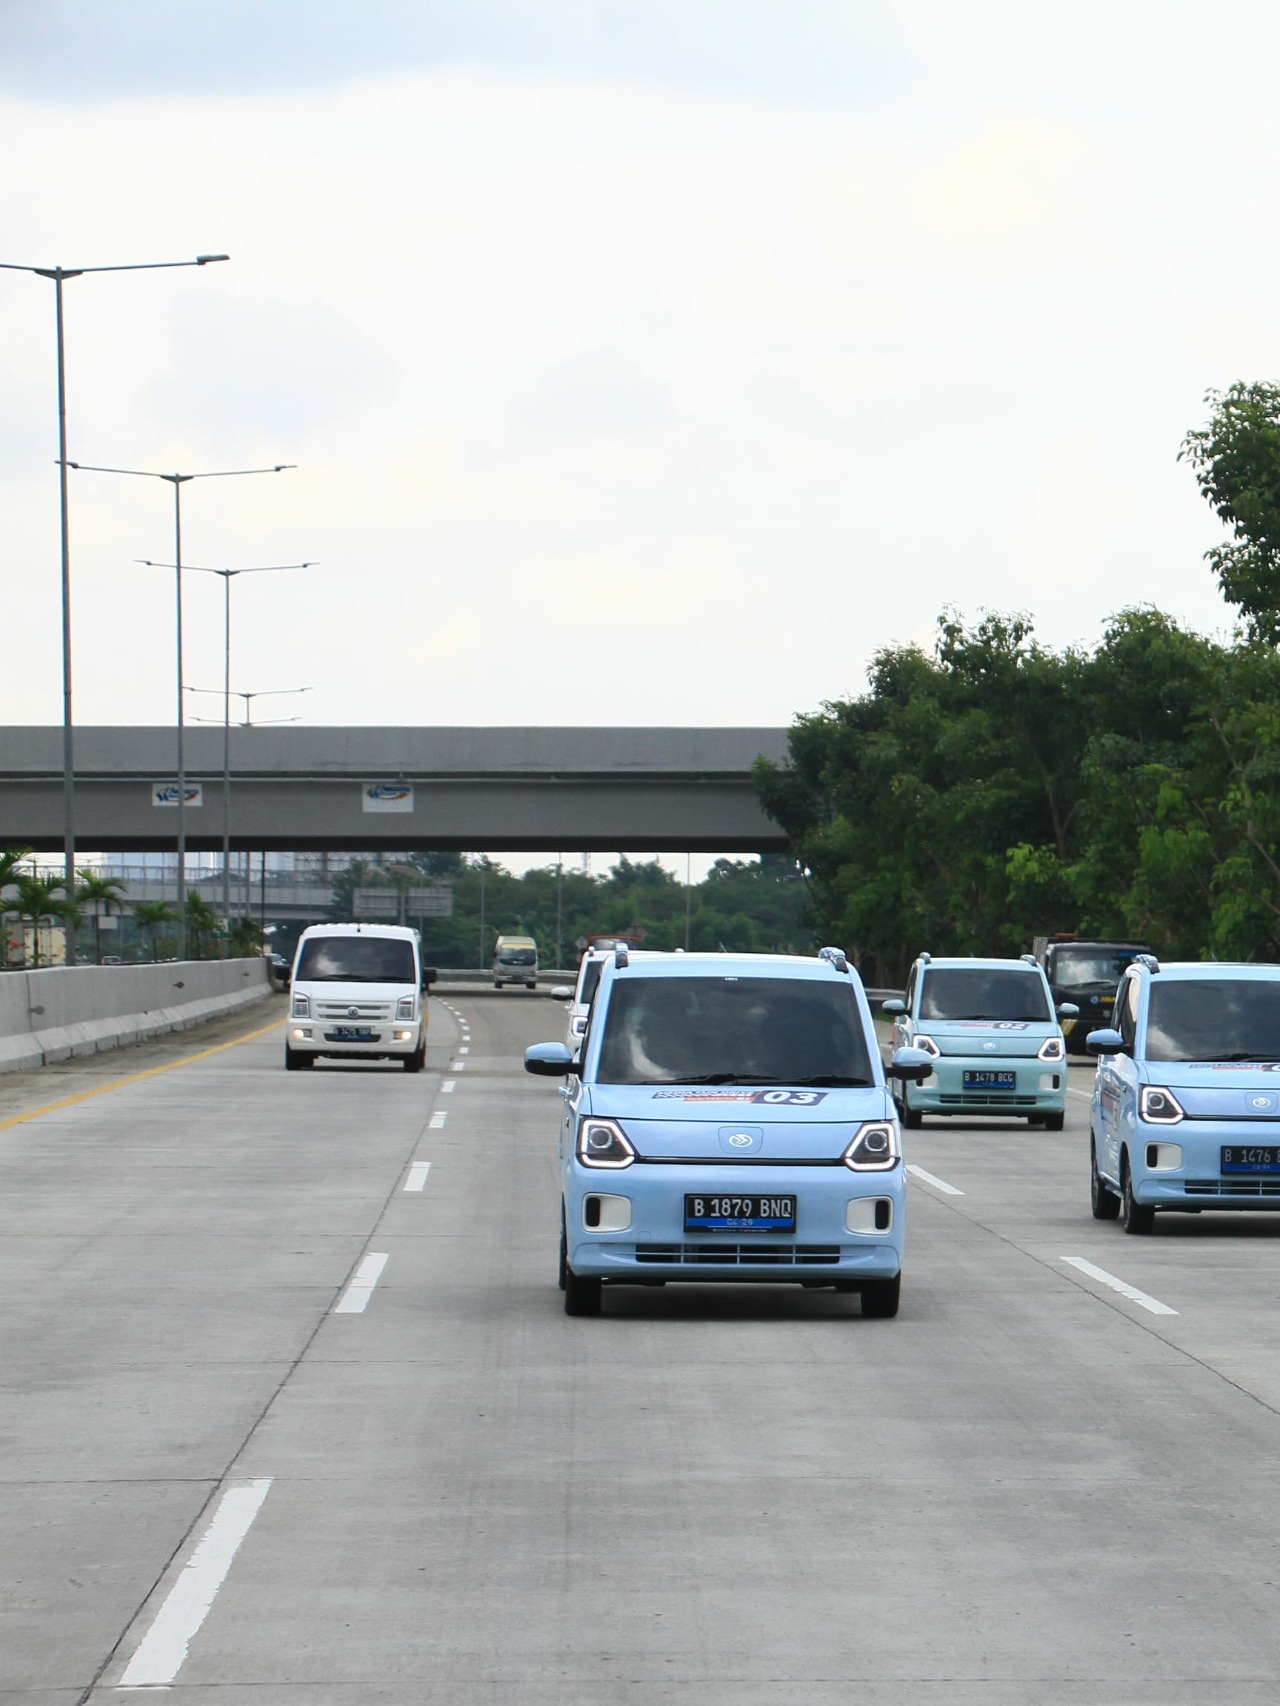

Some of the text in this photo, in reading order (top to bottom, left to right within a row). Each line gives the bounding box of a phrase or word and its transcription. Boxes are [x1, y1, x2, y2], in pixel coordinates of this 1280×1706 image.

[999, 1022, 1026, 1030] 02
[965, 1072, 970, 1081] B
[763, 1091, 818, 1104] 03
[1224, 1149, 1232, 1162] B
[1241, 1149, 1271, 1163] 1476
[694, 1199, 792, 1217] B 1879 BNQ
